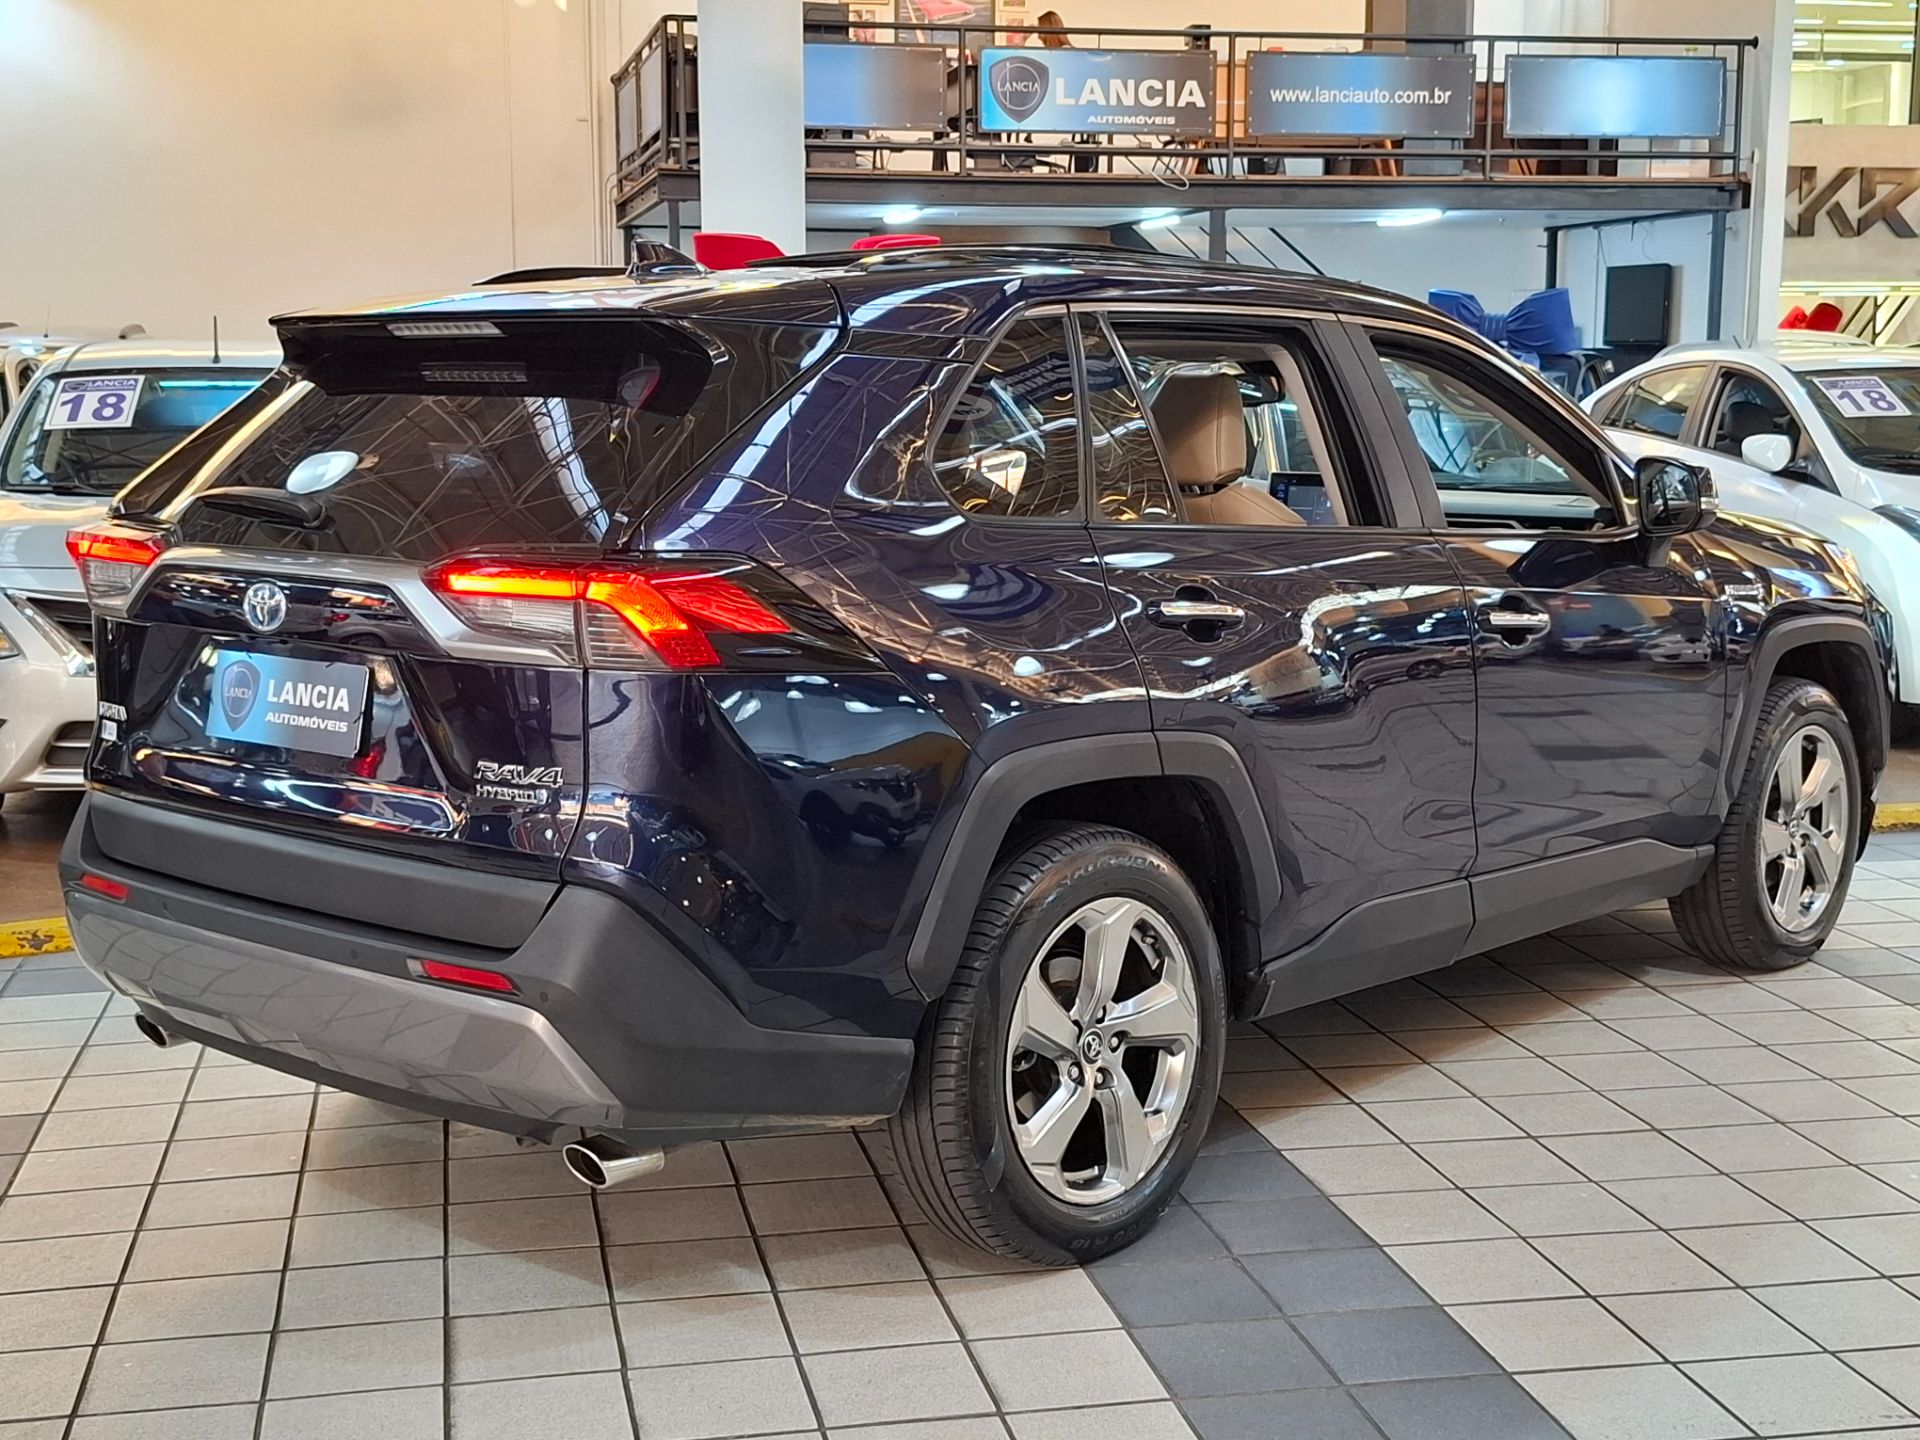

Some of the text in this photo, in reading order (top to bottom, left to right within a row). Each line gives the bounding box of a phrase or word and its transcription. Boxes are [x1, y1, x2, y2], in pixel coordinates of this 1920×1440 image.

[997, 81, 1041, 92] LANCIA
[1055, 77, 1206, 108] LANCIA
[1270, 86, 1452, 104] www.lanciauto.com.br
[1087, 114, 1176, 125] AUTOMÓVEIS
[88, 379, 137, 387] LANCIA
[60, 392, 127, 422] 18
[1837, 390, 1897, 412] 18
[267, 679, 349, 713] LANCIA
[265, 711, 348, 733] AUTOMÓVEIS
[473, 760, 564, 788] RAV4
